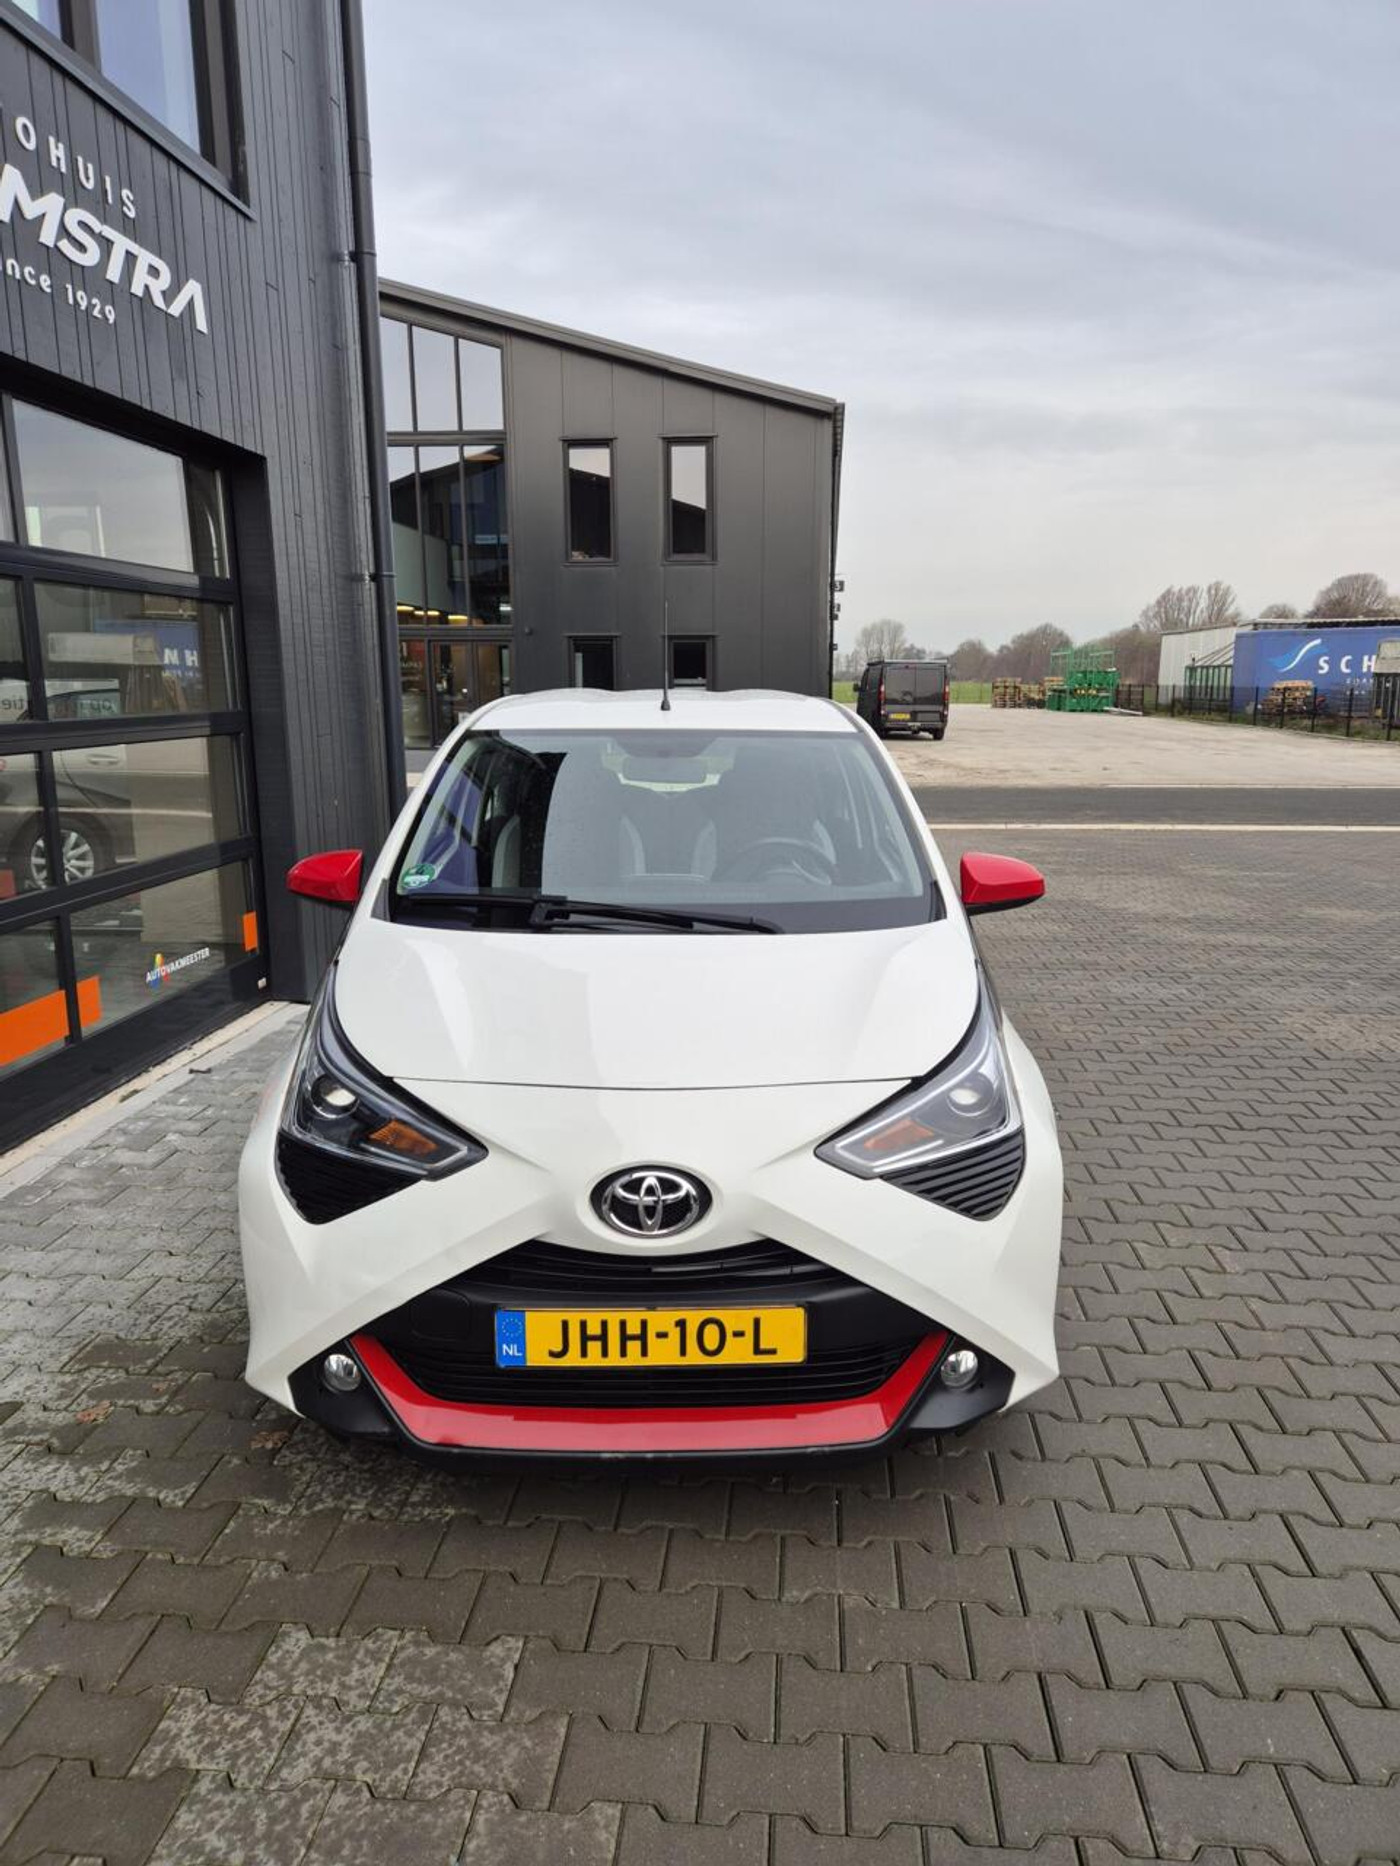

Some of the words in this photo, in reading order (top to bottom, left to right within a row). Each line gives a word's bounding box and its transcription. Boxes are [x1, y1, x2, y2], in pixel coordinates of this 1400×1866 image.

[15, 116, 137, 219] OHUIS
[0, 163, 208, 334] MSTRA
[0, 257, 52, 293] nce
[66, 284, 116, 324] 1929
[1318, 654, 1377, 675] SCH
[502, 1343, 522, 1357] NL
[548, 1316, 778, 1359] JHH-10-L
